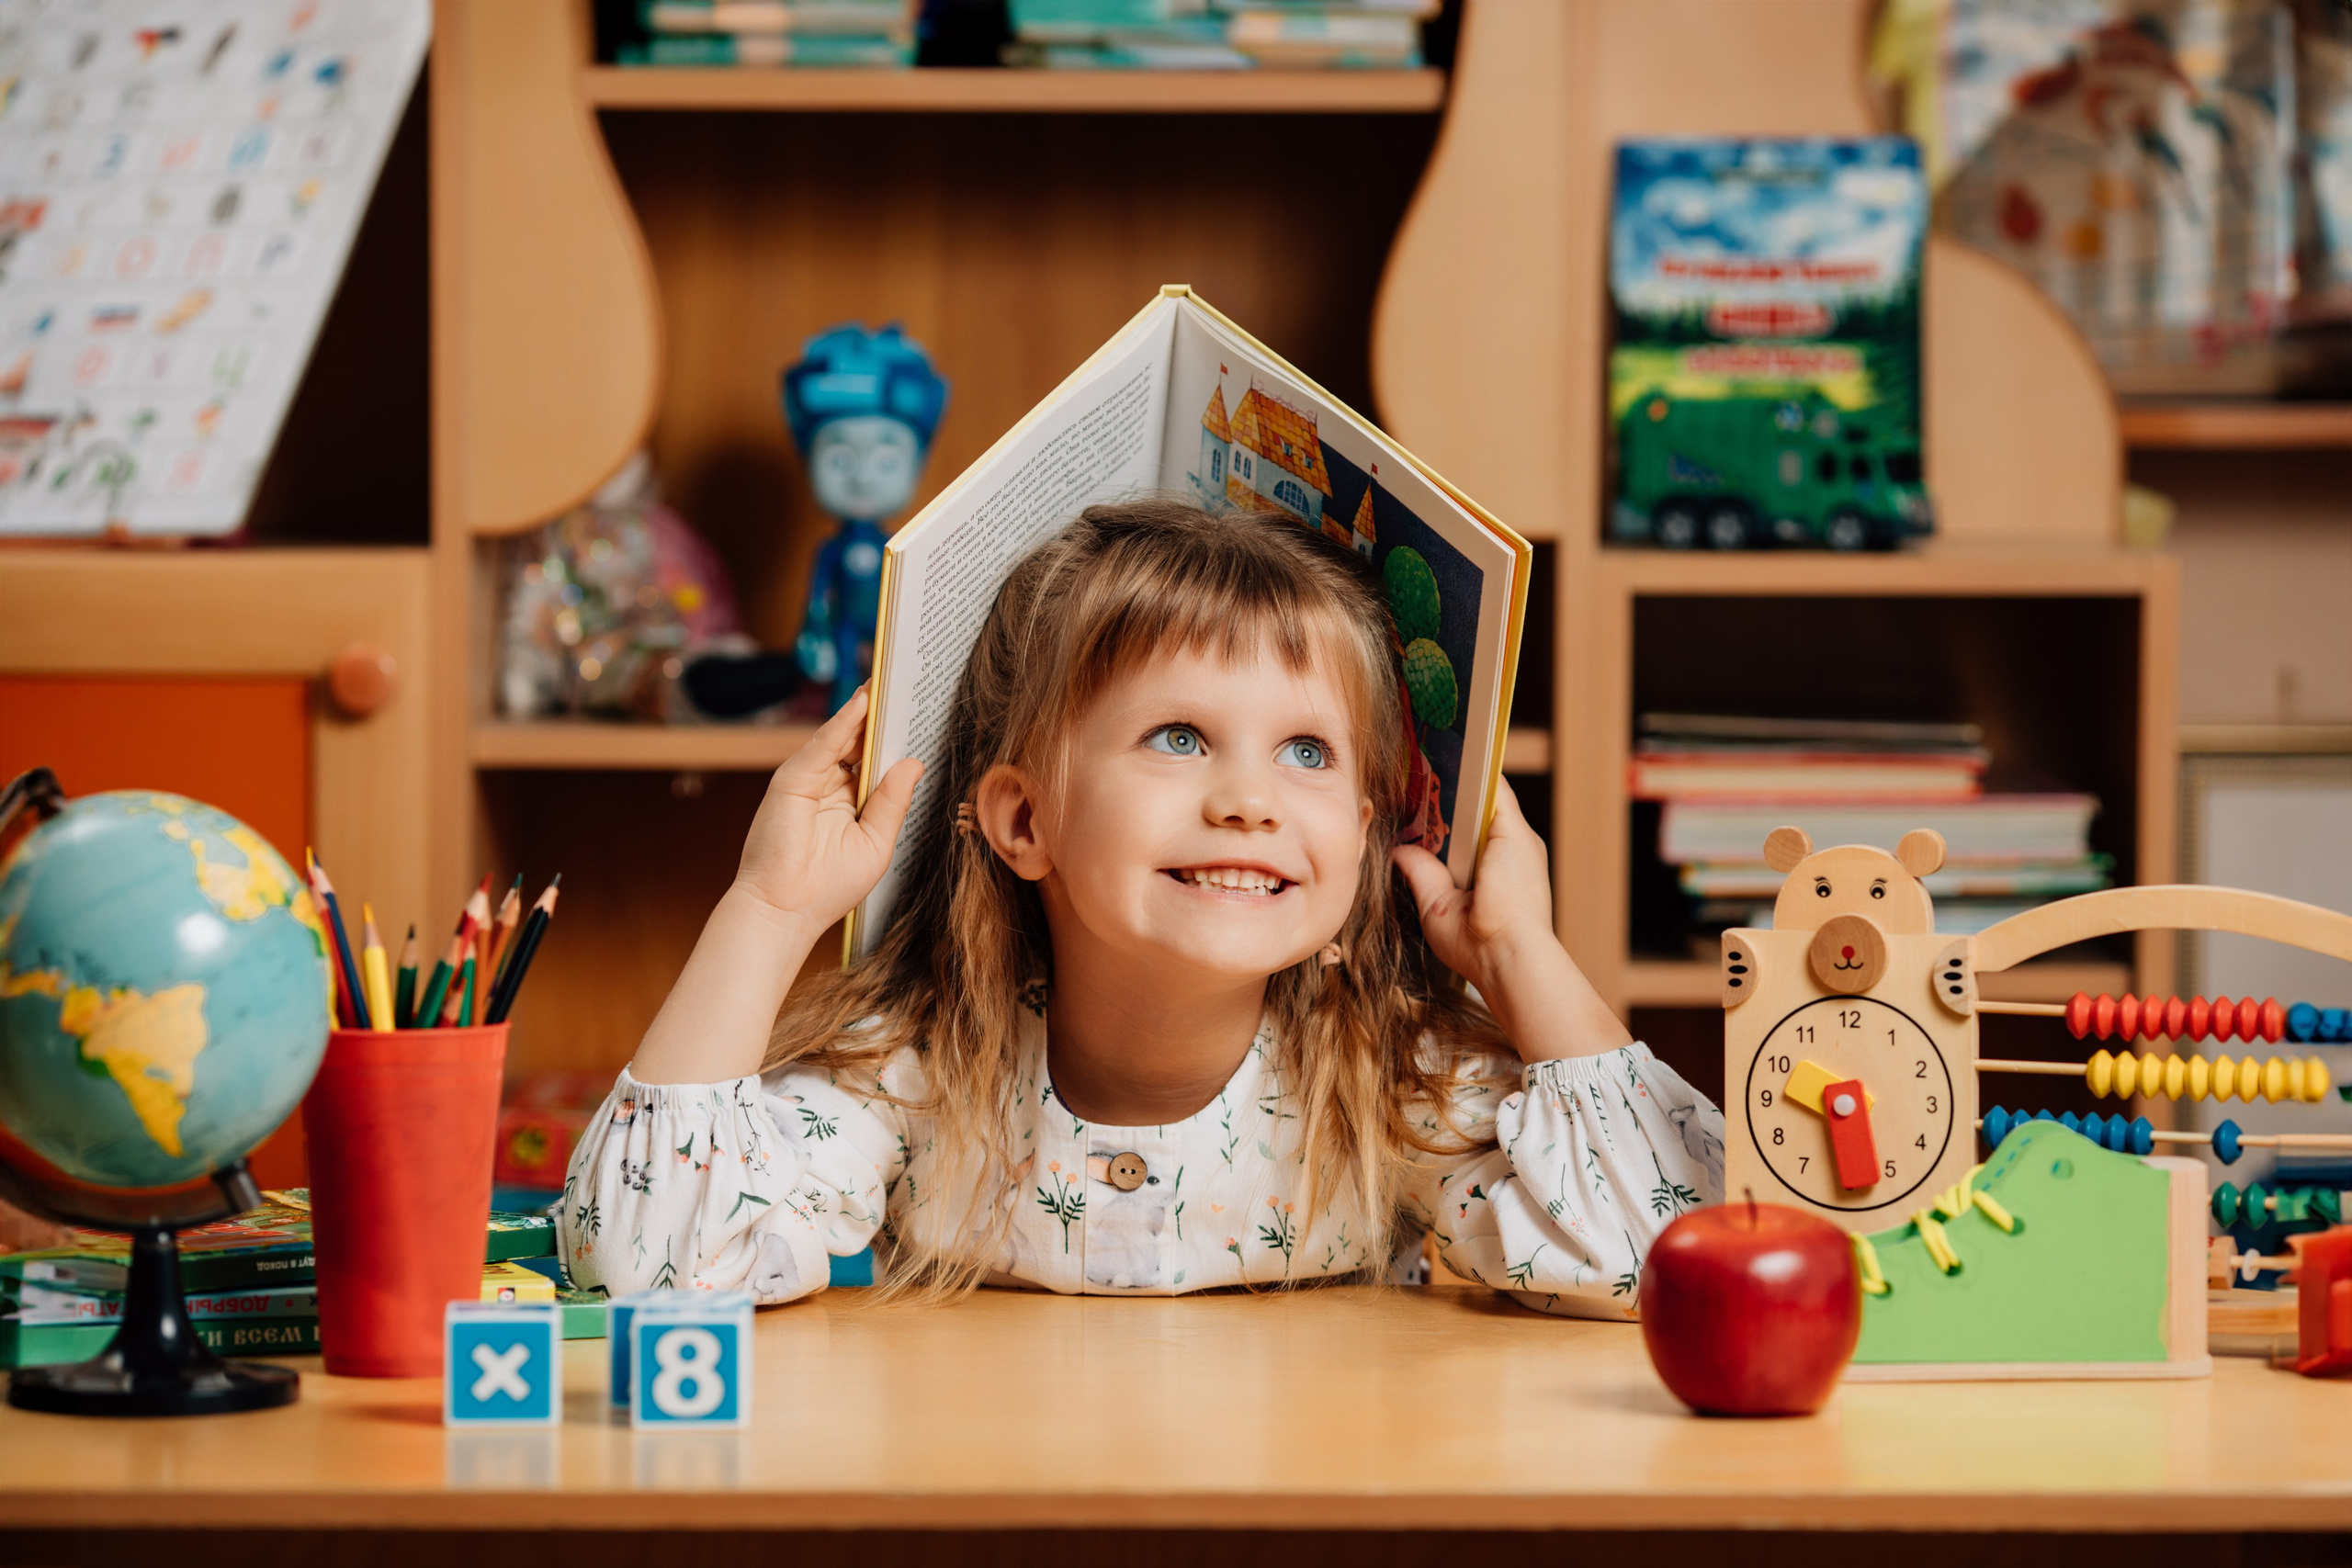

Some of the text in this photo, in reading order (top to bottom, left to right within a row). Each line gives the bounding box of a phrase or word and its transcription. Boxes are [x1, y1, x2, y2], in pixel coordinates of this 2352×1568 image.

[1838, 1010, 1861, 1029] 12
[1795, 1026, 1815, 1043] 11
[1887, 1029, 1895, 1046] 1
[1768, 1055, 1791, 1073] 10
[1916, 1061, 1927, 1078] 2
[1761, 1090, 1772, 1107] 9
[1927, 1096, 1938, 1113] 3
[1773, 1128, 1784, 1145] 8
[1916, 1134, 1927, 1150] 4
[1798, 1157, 1810, 1174] 7
[1884, 1160, 1896, 1178] 5
[256, 1260, 288, 1271] поход
[298, 1256, 317, 1268] дут
[652, 1328, 726, 1417] 8
